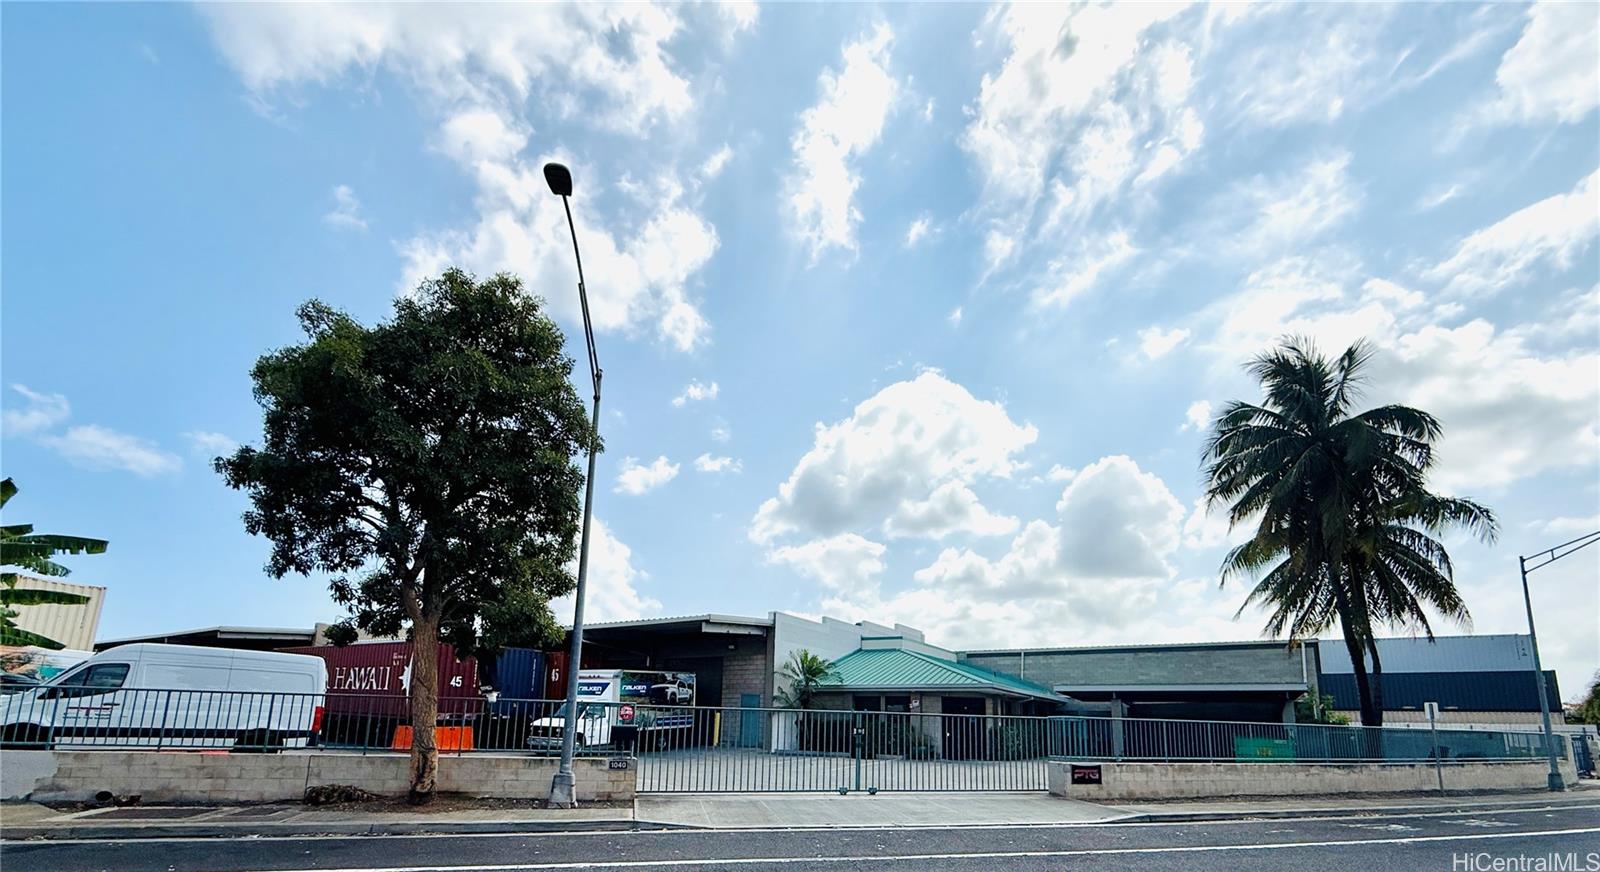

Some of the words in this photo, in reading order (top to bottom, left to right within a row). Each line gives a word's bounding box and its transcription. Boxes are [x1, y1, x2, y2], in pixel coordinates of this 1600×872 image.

[333, 667, 390, 690] HAWAII
[551, 668, 560, 682] 45
[450, 676, 462, 687] 45
[1074, 769, 1099, 779] PTG
